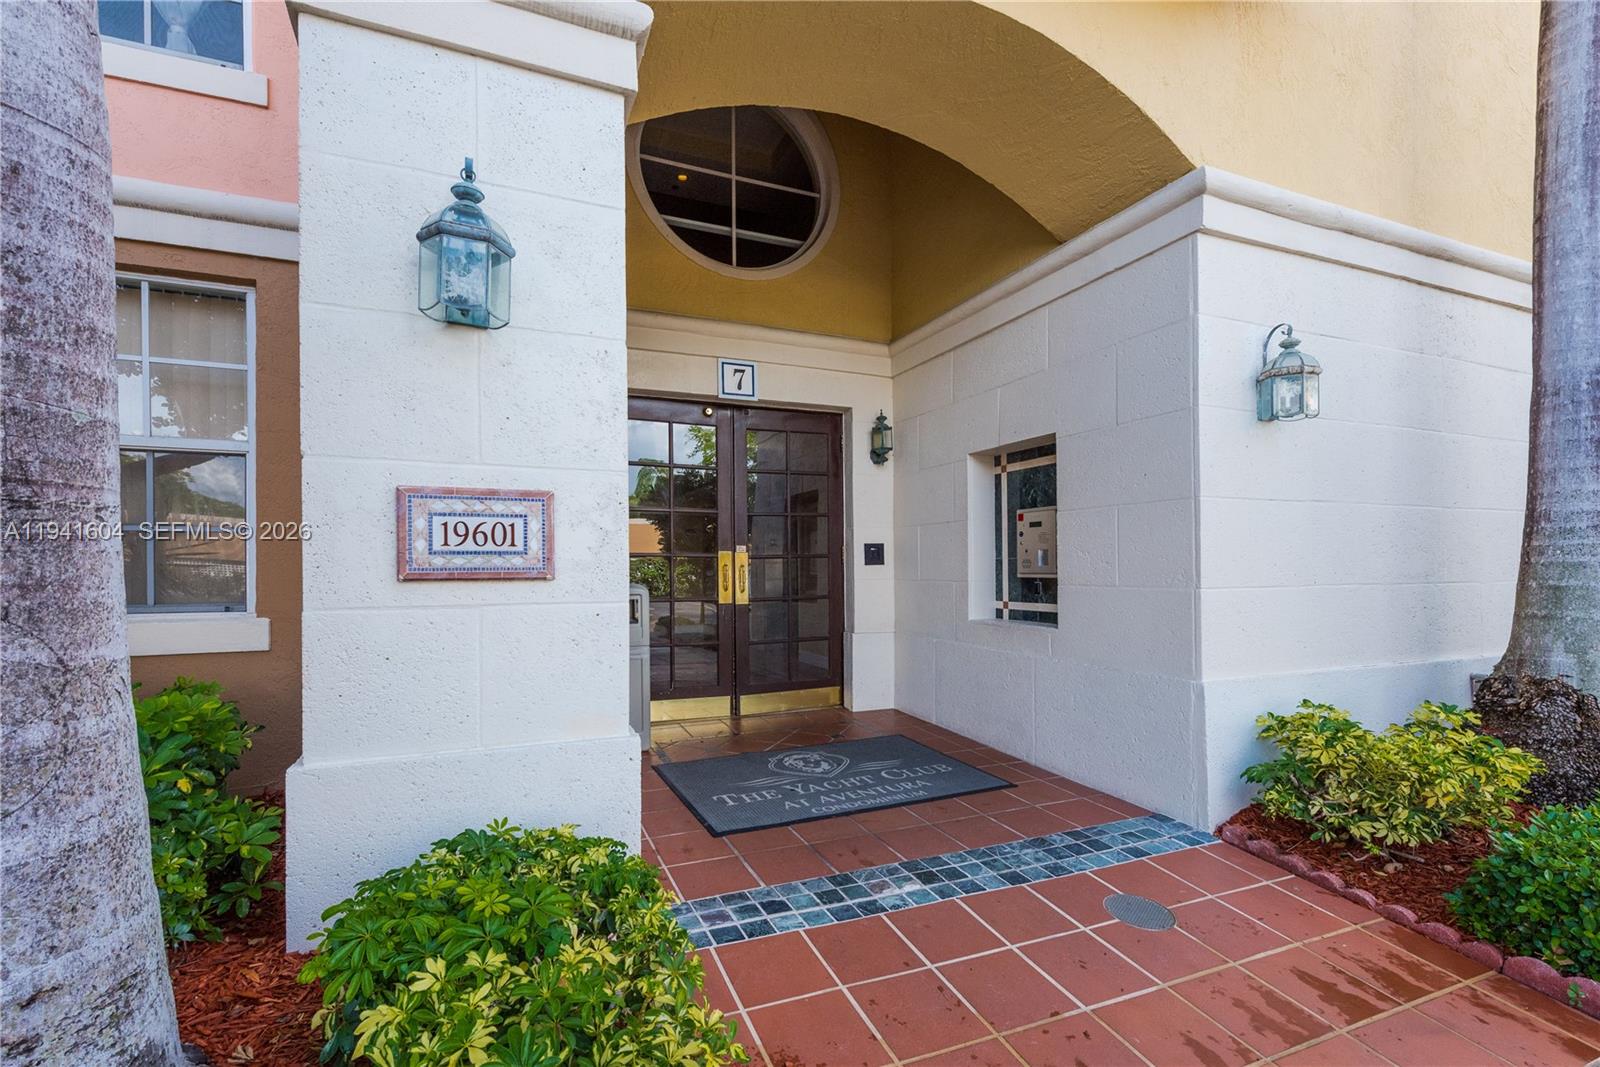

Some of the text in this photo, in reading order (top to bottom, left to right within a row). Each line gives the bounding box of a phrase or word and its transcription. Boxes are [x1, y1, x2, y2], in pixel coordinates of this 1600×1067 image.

[732, 368, 746, 391] 7
[440, 520, 518, 547] 19601
[782, 774, 876, 795] YACHT
[880, 763, 953, 780] CLUB
[784, 779, 933, 810] AT AVENTURA
[811, 790, 928, 814] CONDOMINIUM
